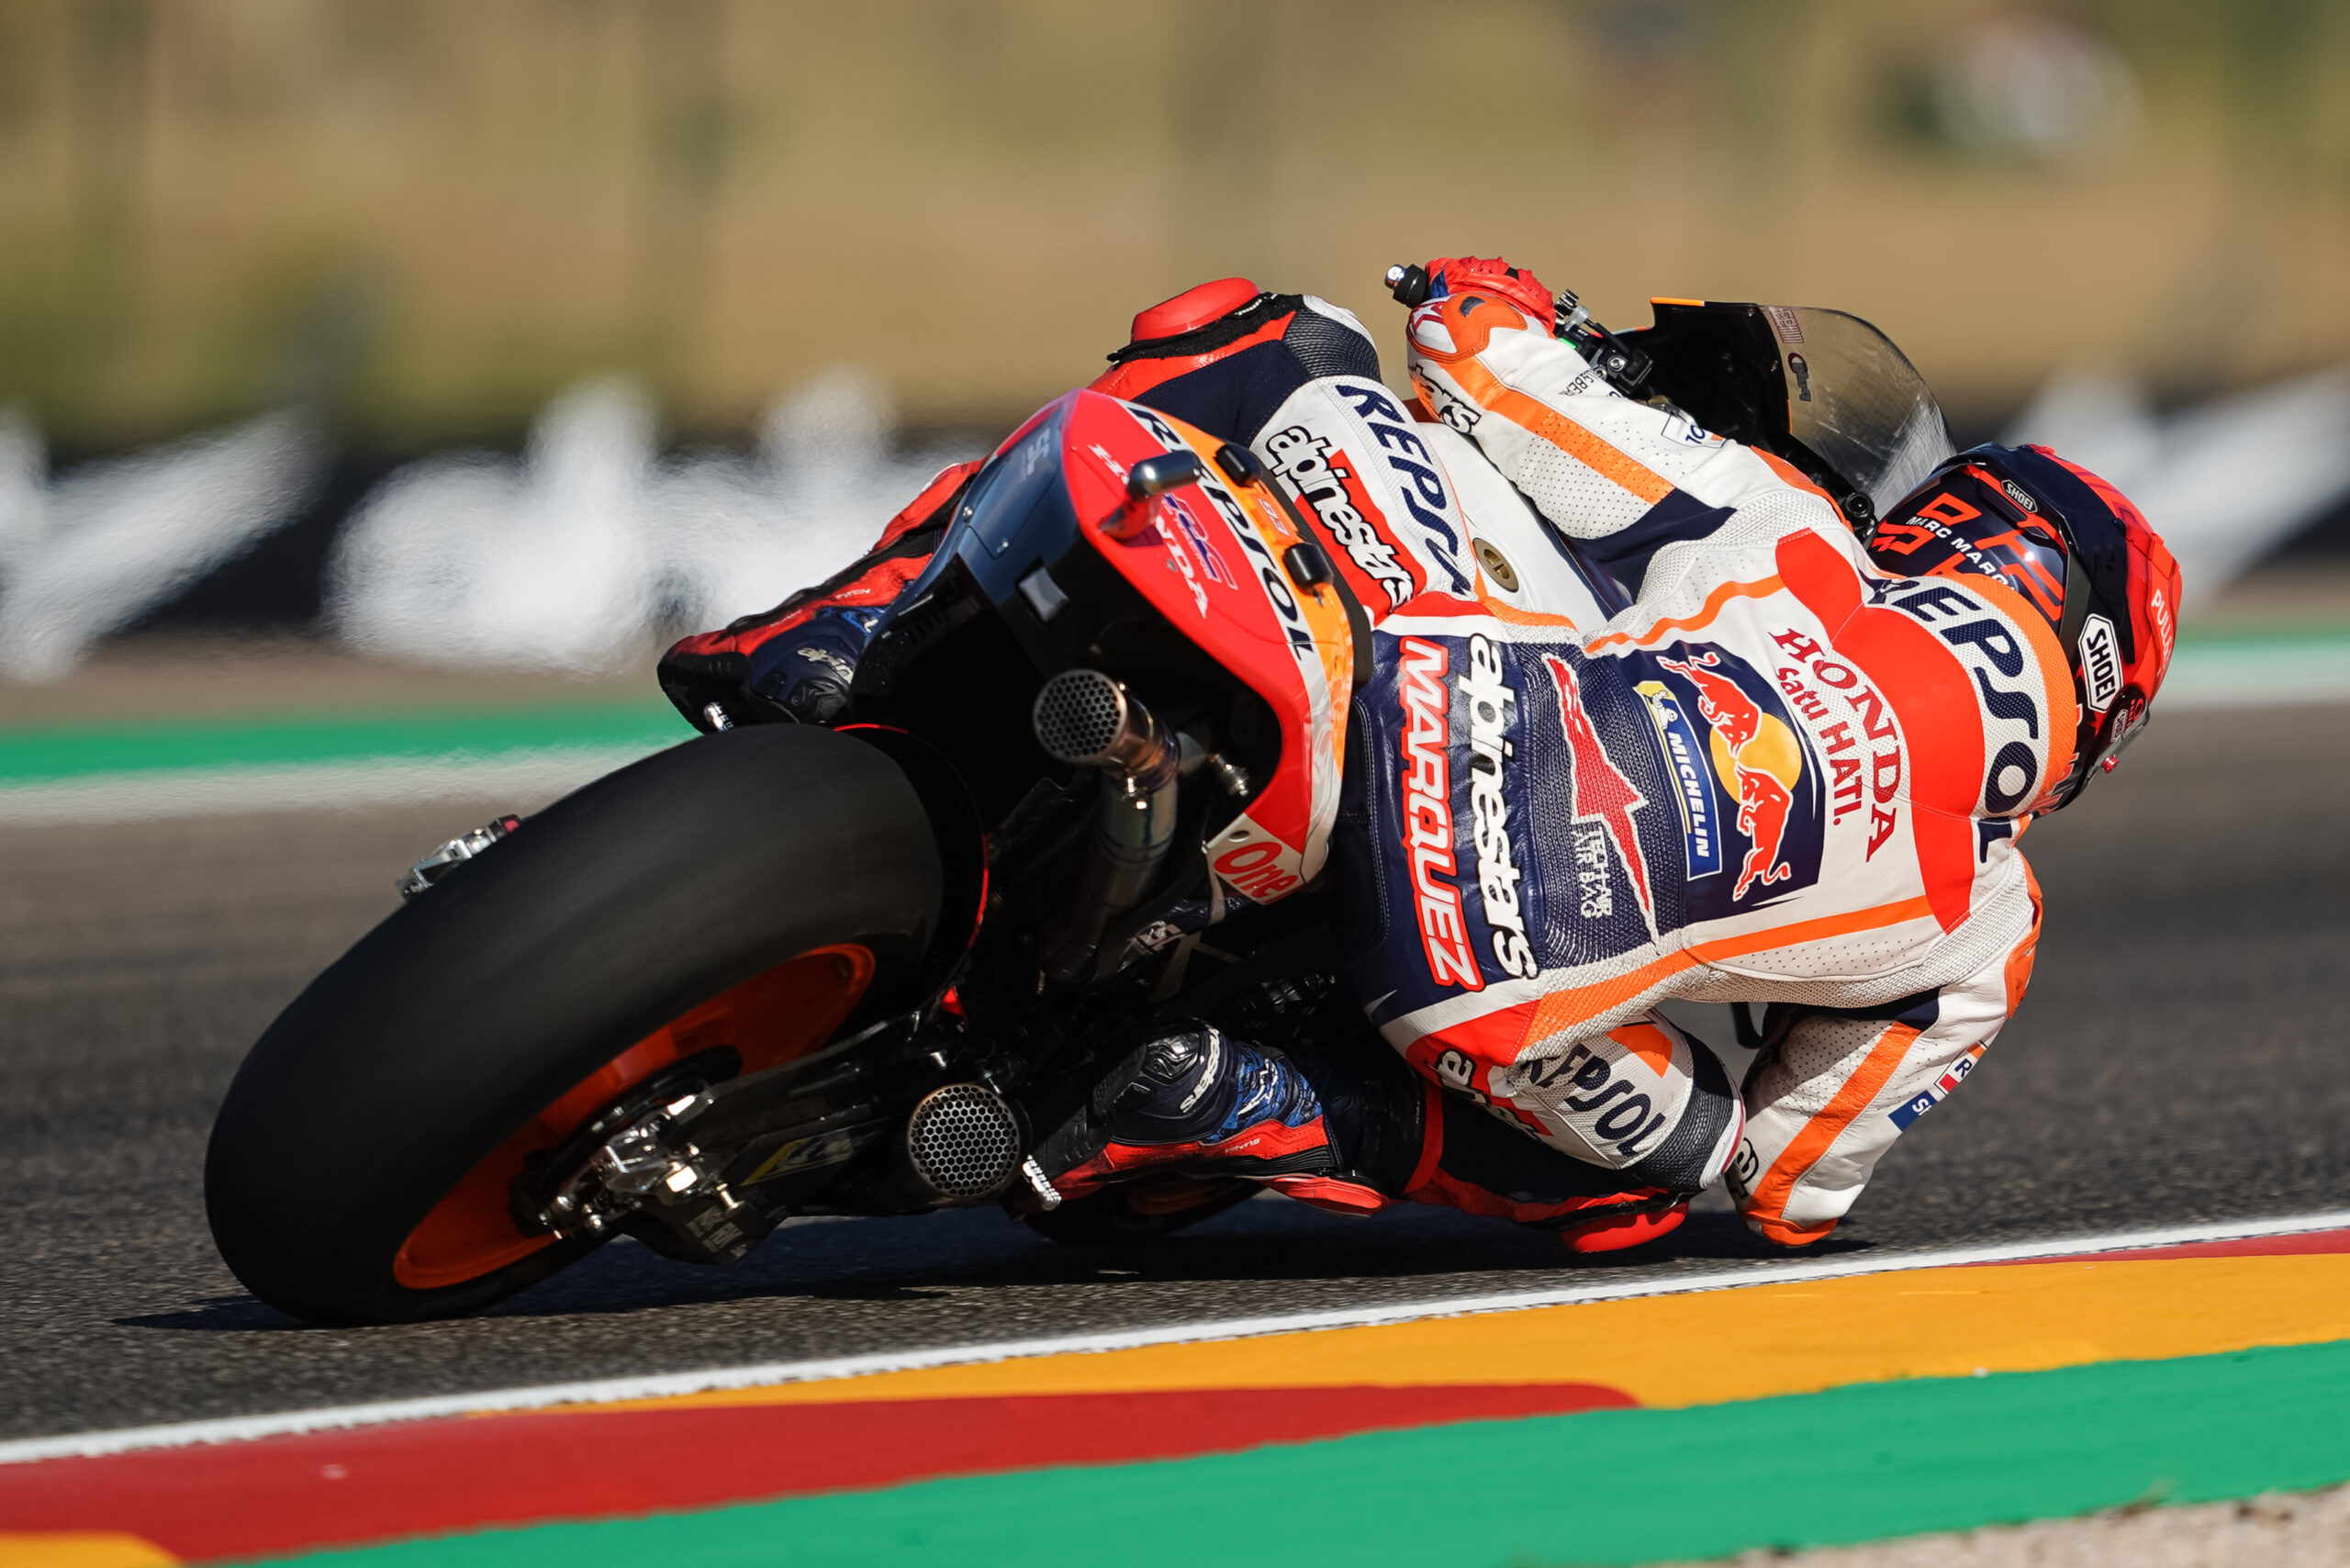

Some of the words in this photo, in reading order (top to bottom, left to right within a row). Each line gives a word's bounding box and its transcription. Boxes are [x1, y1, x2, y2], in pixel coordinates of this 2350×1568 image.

[1088, 443, 1209, 619] HNDA
[1126, 407, 1314, 662] RPSOL
[1266, 425, 1415, 614] alpinestars
[1906, 516, 1952, 538] MARC
[2005, 483, 2035, 513] SHOEI
[2086, 628, 2116, 703] SHOEI
[1401, 636, 1483, 991] MARQUEZ
[1457, 633, 1539, 980] alpinestars
[1667, 731, 1709, 857] MICHELIN
[1768, 628, 1901, 862] HONDA
[1818, 721, 1863, 826] HATI.
[1214, 842, 1298, 898] One
